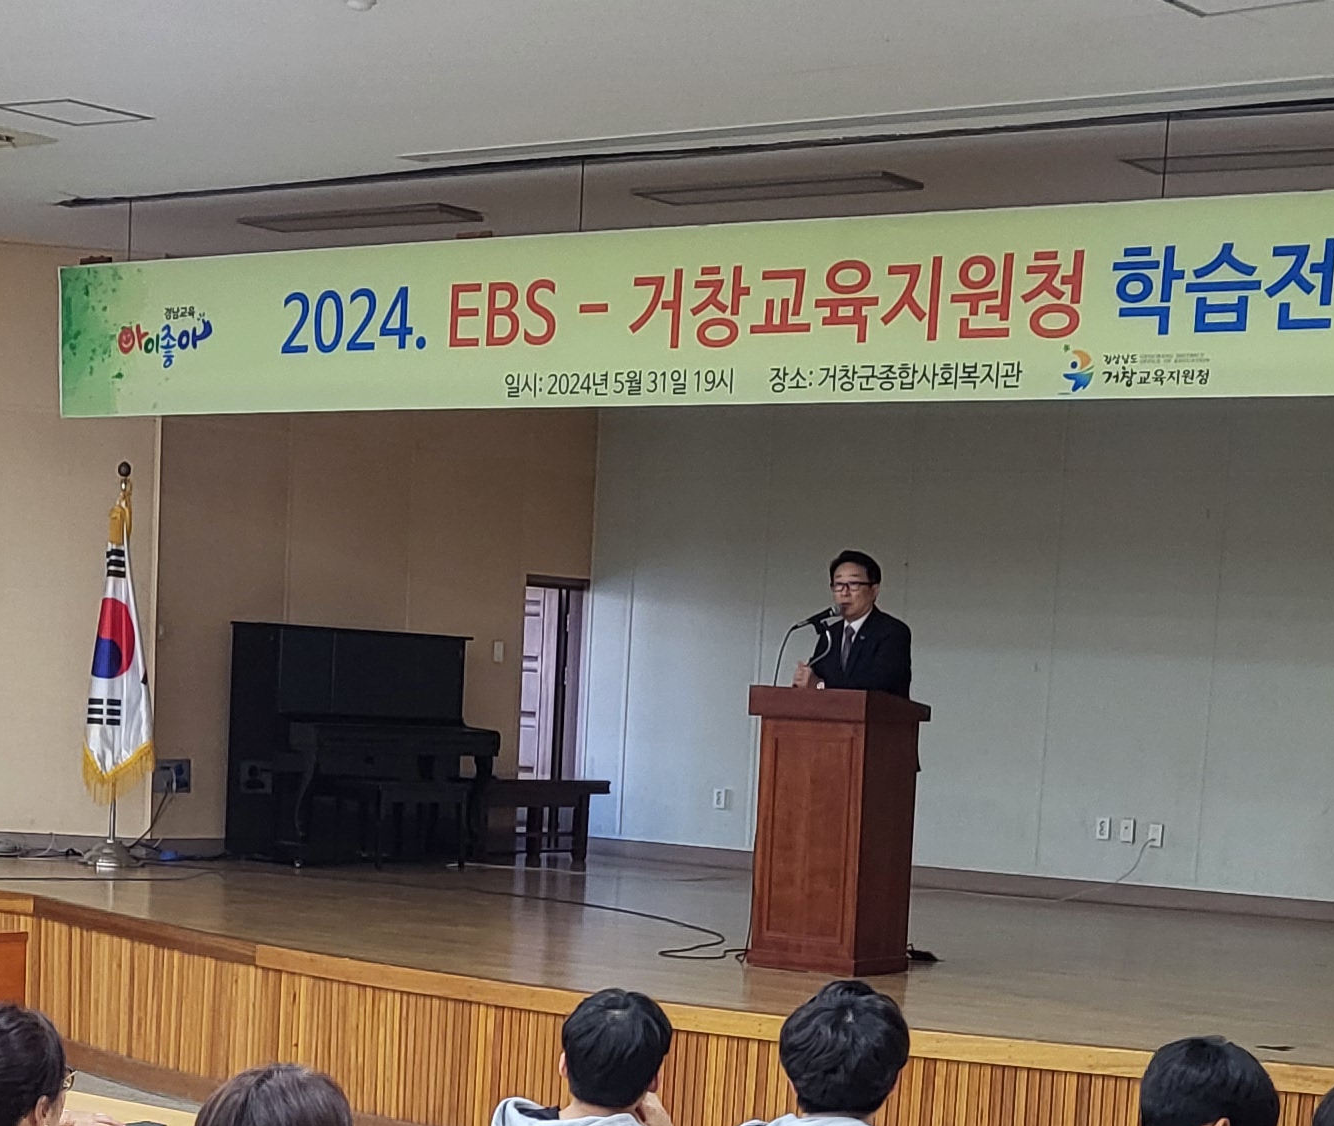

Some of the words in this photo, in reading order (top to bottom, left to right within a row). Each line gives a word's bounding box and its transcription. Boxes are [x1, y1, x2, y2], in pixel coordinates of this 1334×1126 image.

[164, 306, 196, 320] 경남교육
[280, 285, 427, 354] 2024.
[448, 278, 557, 348] EBS
[628, 248, 1086, 350] 거창교육지원청
[1103, 353, 1138, 365] 경상남도
[504, 372, 543, 398] 일시:
[547, 370, 609, 396] 2024년
[612, 369, 643, 396] 5월
[646, 368, 687, 395] 31일
[693, 367, 734, 394] 19시
[768, 366, 813, 393] 장소:
[817, 360, 1023, 392] 거창군종합사회복지관
[1101, 365, 1210, 388] 거창교육지원청
